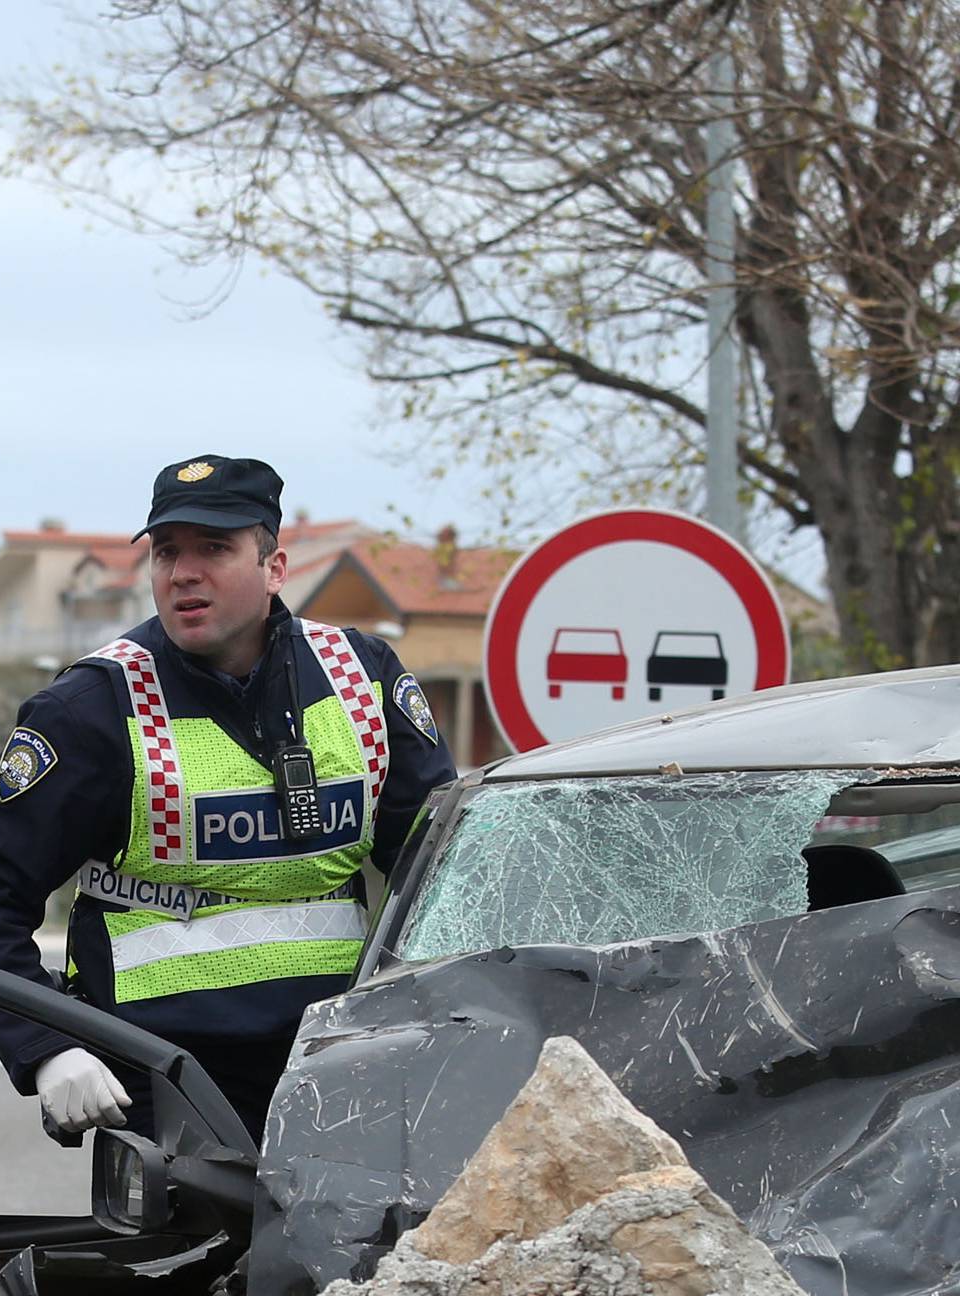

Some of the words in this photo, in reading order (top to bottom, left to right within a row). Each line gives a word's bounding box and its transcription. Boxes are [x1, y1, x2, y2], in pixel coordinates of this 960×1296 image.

[13, 731, 51, 766] POLICIJA
[203, 799, 357, 844] POLIJA
[88, 867, 188, 914] POLICIJA
